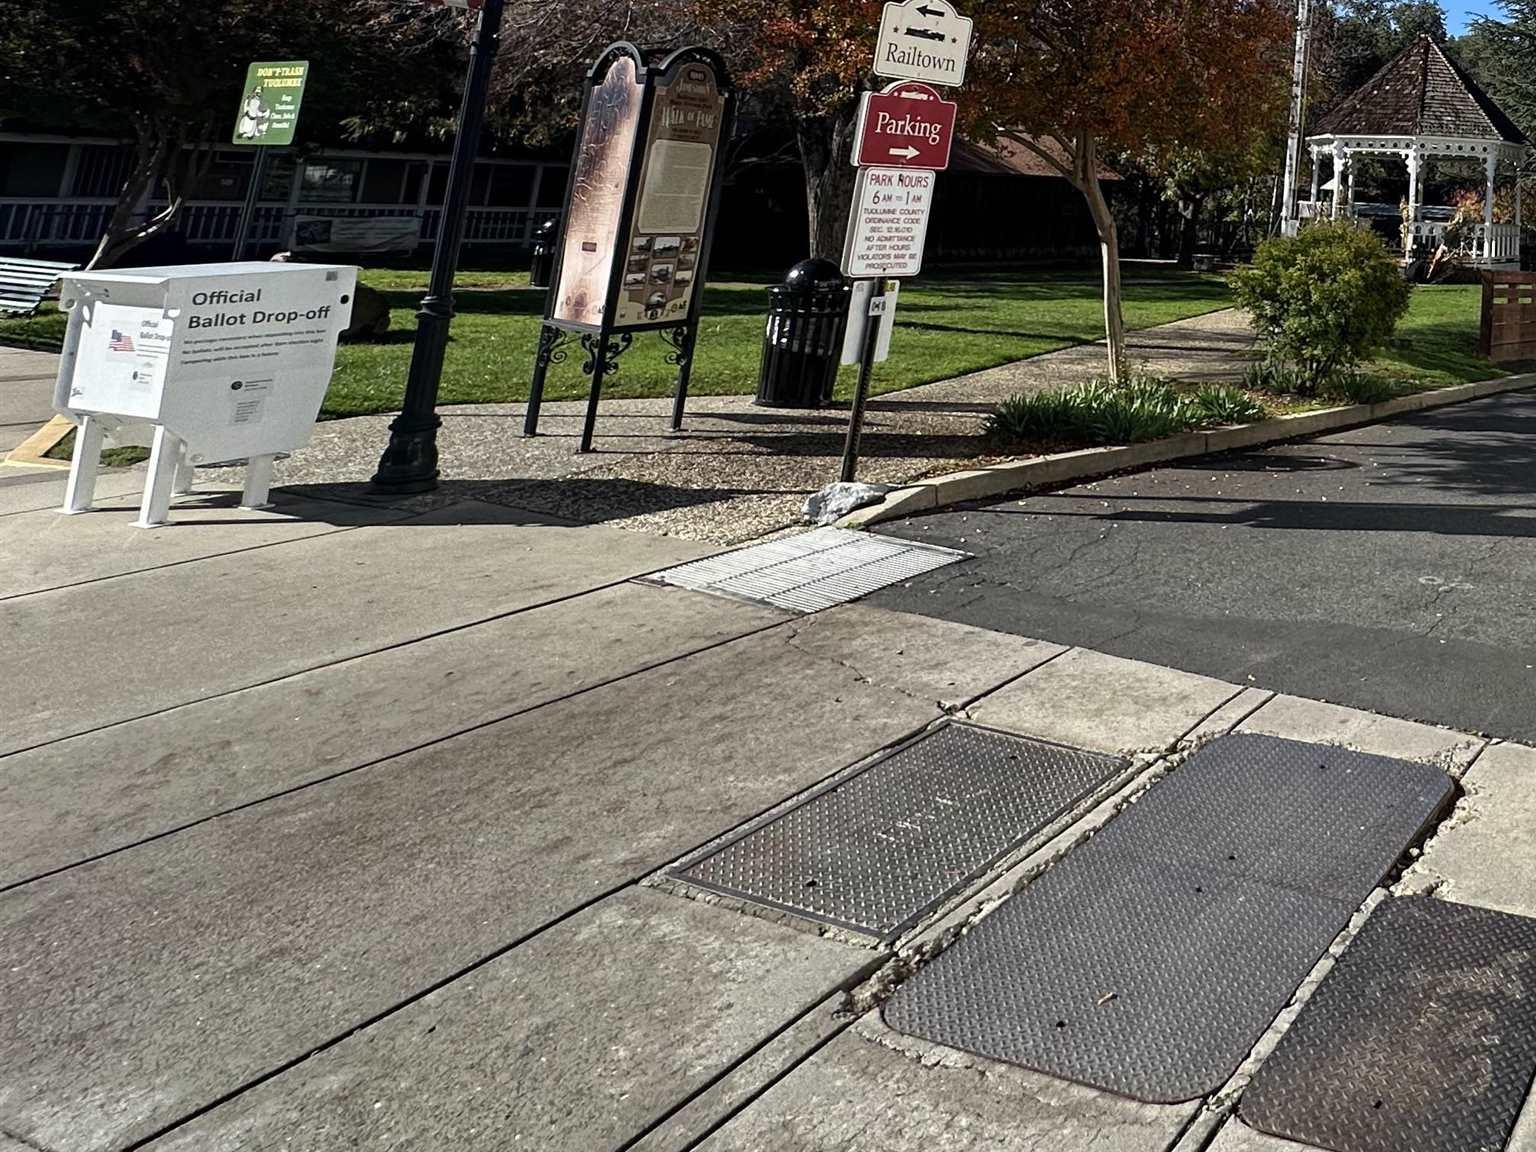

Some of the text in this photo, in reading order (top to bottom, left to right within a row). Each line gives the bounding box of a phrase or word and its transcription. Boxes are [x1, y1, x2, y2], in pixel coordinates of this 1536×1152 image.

[885, 42, 956, 72] Railtown
[874, 111, 943, 145] Parking
[869, 174, 929, 188] PARK HOURS
[872, 190, 881, 205] 6
[882, 193, 893, 202] AM
[192, 288, 262, 306] Official
[188, 305, 331, 329] Ballot Drop-off
